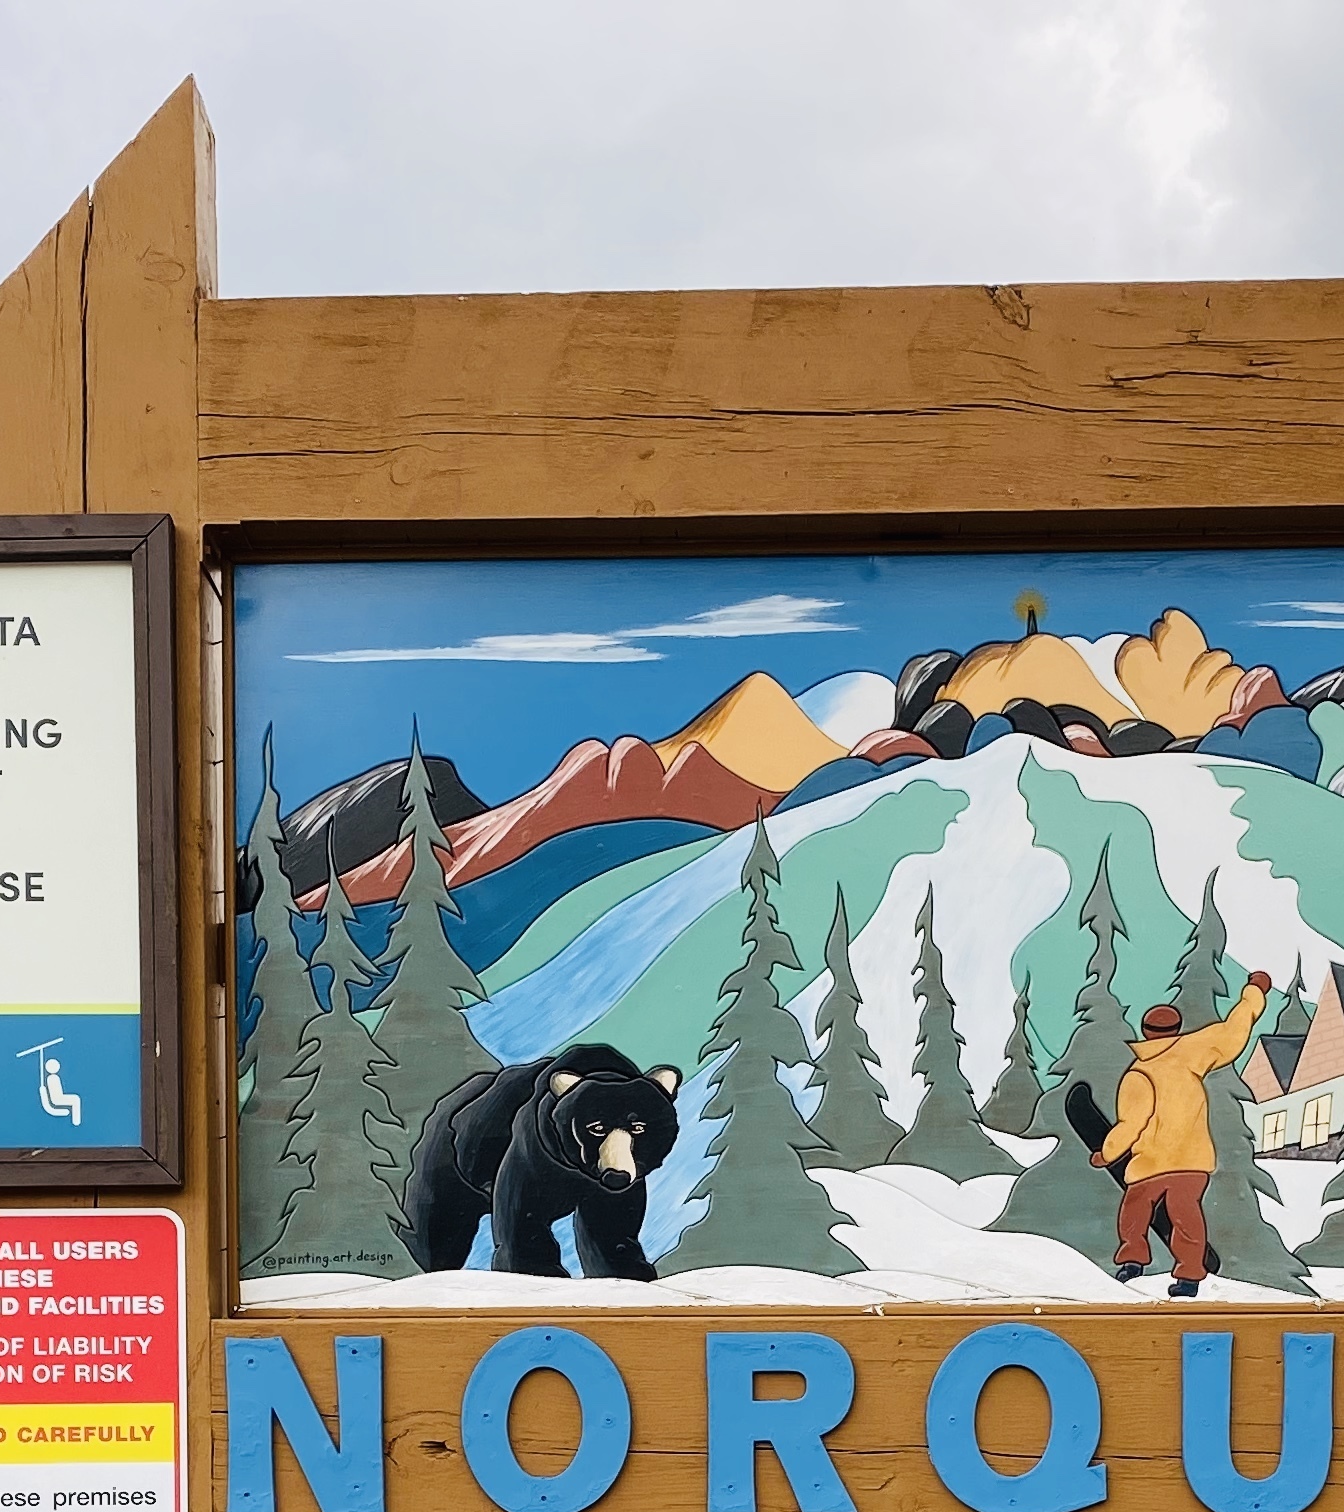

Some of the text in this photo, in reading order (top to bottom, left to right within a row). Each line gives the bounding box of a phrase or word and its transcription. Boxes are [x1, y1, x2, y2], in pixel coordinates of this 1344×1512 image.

[54, 1241, 138, 1259] USERS
[262, 1249, 394, 1269] @painting.art.design
[29, 1296, 164, 1314] FACILITIES
[34, 1337, 152, 1355] LIABILITY
[33, 1365, 65, 1383] OF
[75, 1364, 133, 1382] RISK
[18, 1426, 154, 1443] CAREFULLY
[54, 1487, 156, 1510] premises
